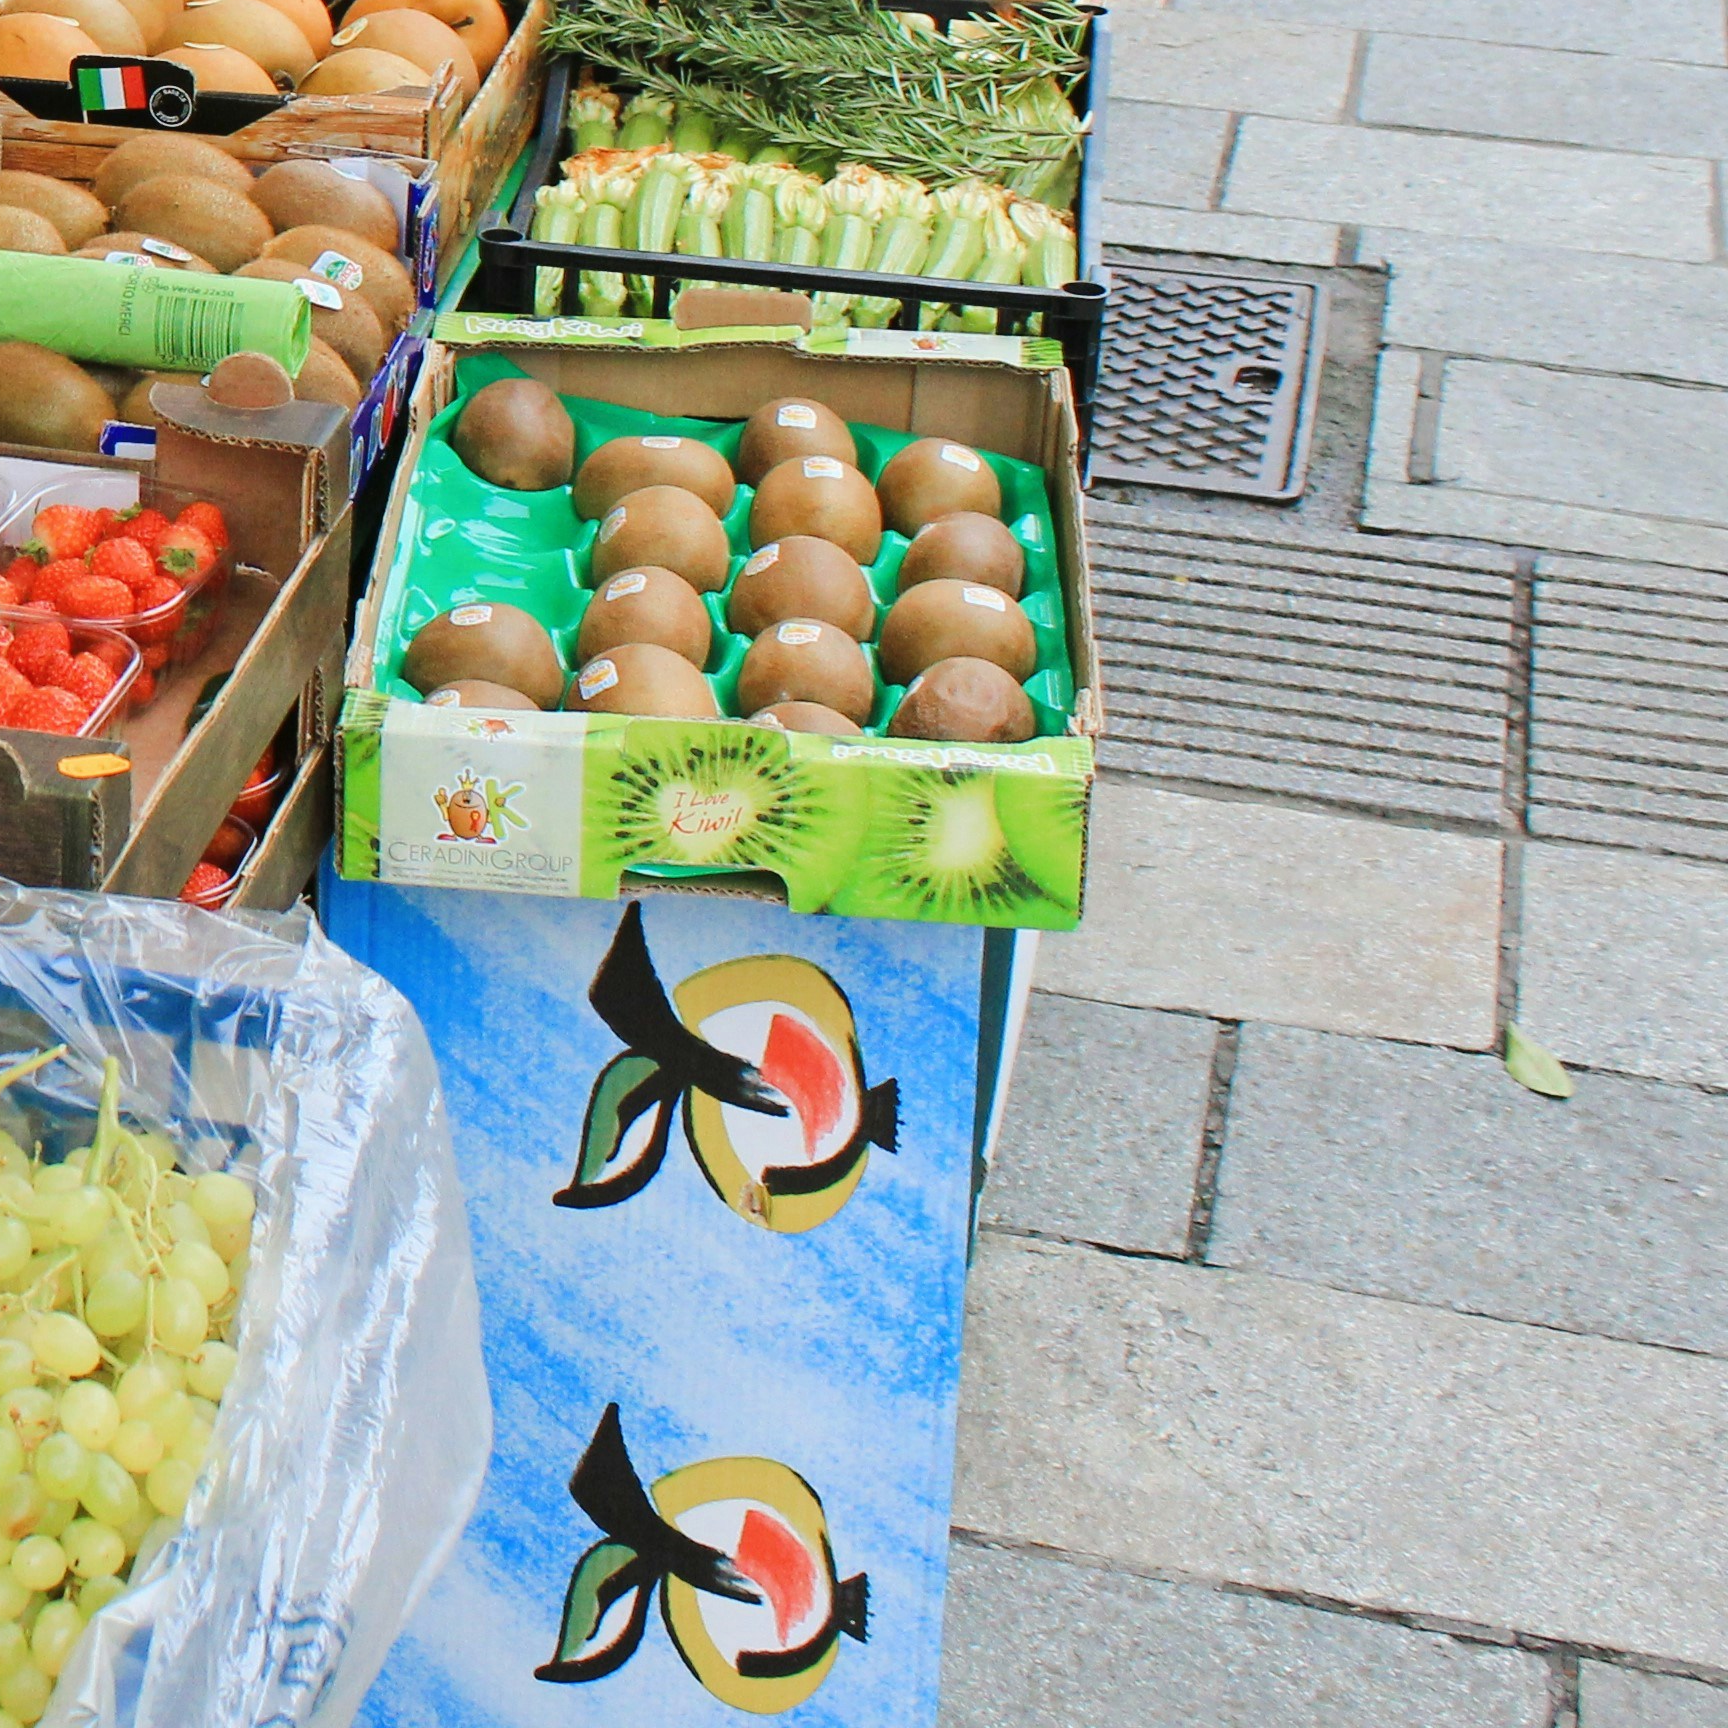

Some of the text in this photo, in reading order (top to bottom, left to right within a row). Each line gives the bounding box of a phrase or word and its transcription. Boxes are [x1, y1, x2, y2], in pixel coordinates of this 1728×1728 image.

[170, 283, 204, 296] Verde
[672, 788, 731, 809] I Love
[670, 806, 744, 837] Kiwi!
